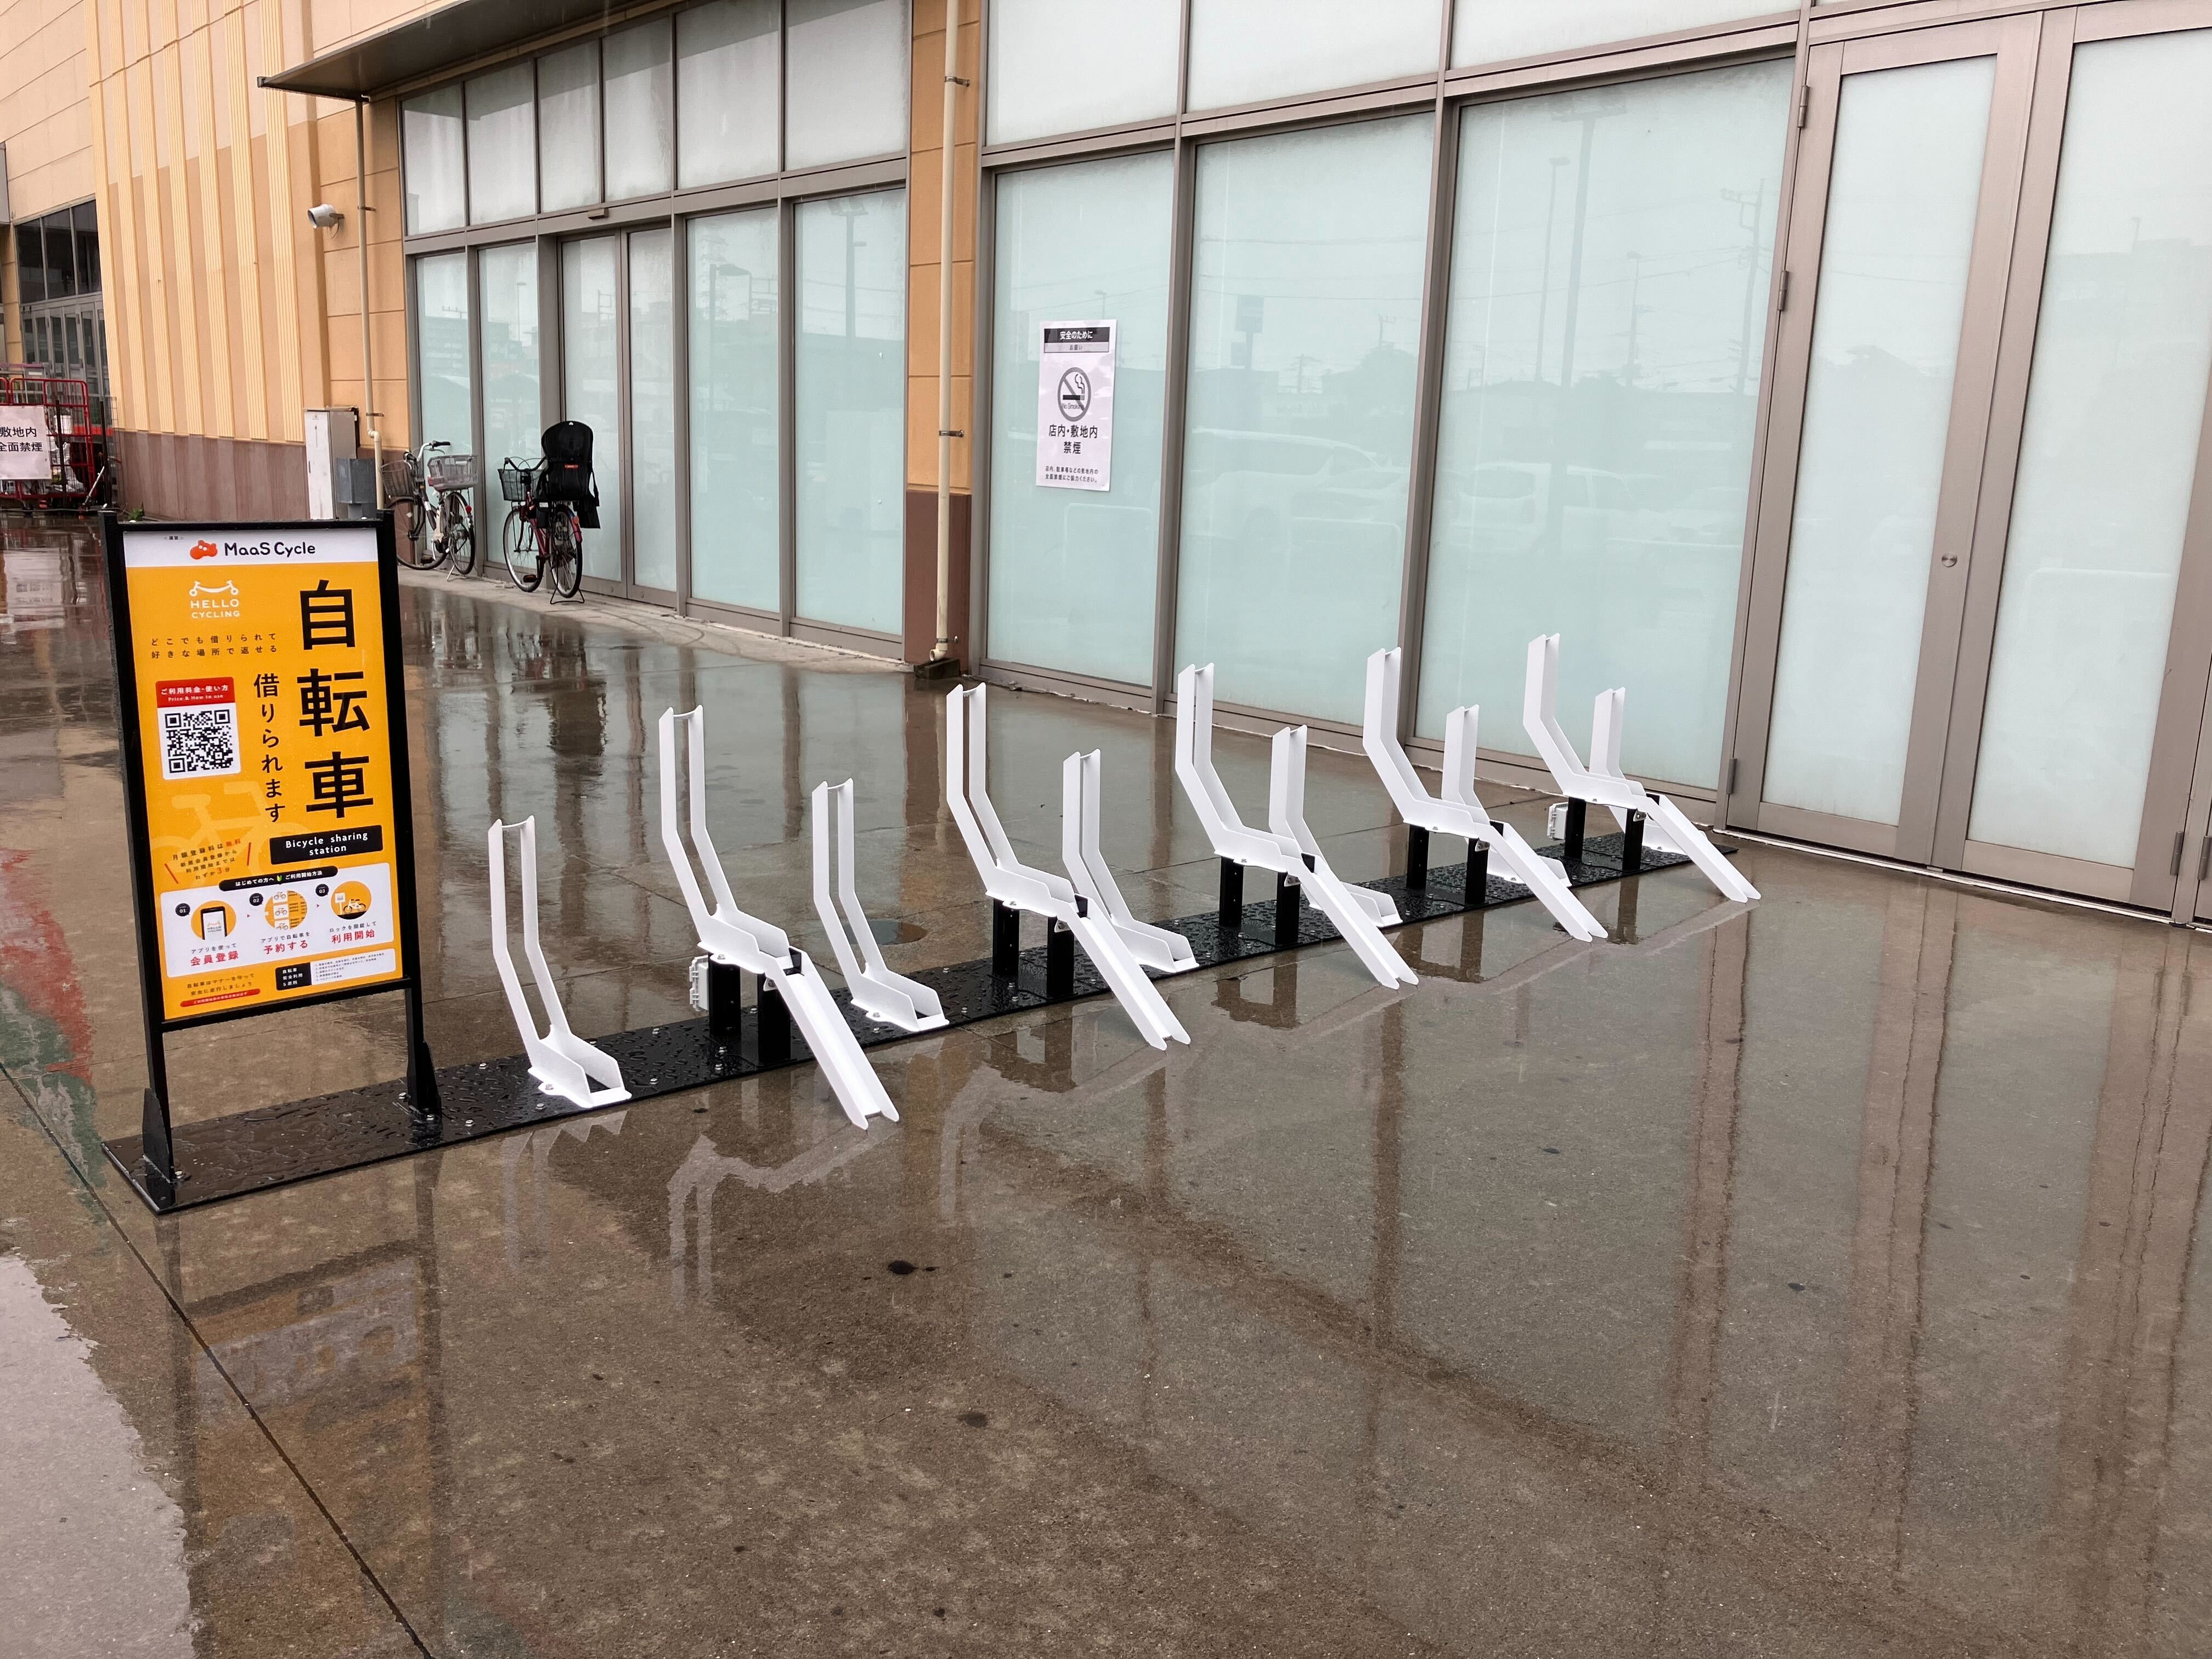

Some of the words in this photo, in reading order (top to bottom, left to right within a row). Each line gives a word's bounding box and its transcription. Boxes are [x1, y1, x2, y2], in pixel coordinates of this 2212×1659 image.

[1060, 330, 1093, 340] 安全のために
[1048, 424, 1098, 438] 店内・敷地内
[0, 441, 43, 452] 全面禁煙
[1063, 441, 1082, 454] 禁煙
[224, 542, 270, 556] MaaS
[274, 541, 316, 557] Cycle
[190, 598, 240, 609] HELLO
[191, 610, 241, 619] CYCLING
[151, 633, 276, 646] どこでも借りられて
[151, 645, 277, 659] 好きな場所で返せる
[161, 684, 229, 696] ご利用料金・使い方
[297, 579, 374, 819] 自転車
[253, 672, 286, 823] 借りられます
[285, 837, 324, 848] Bicycle
[330, 832, 368, 843] sharing
[309, 845, 347, 856] station
[235, 877, 274, 887] はじめての方へ
[331, 929, 375, 944] 利用開始
[191, 943, 237, 954] アプリを使って
[263, 940, 308, 955] 予約する
[190, 950, 239, 967] 会員登録
